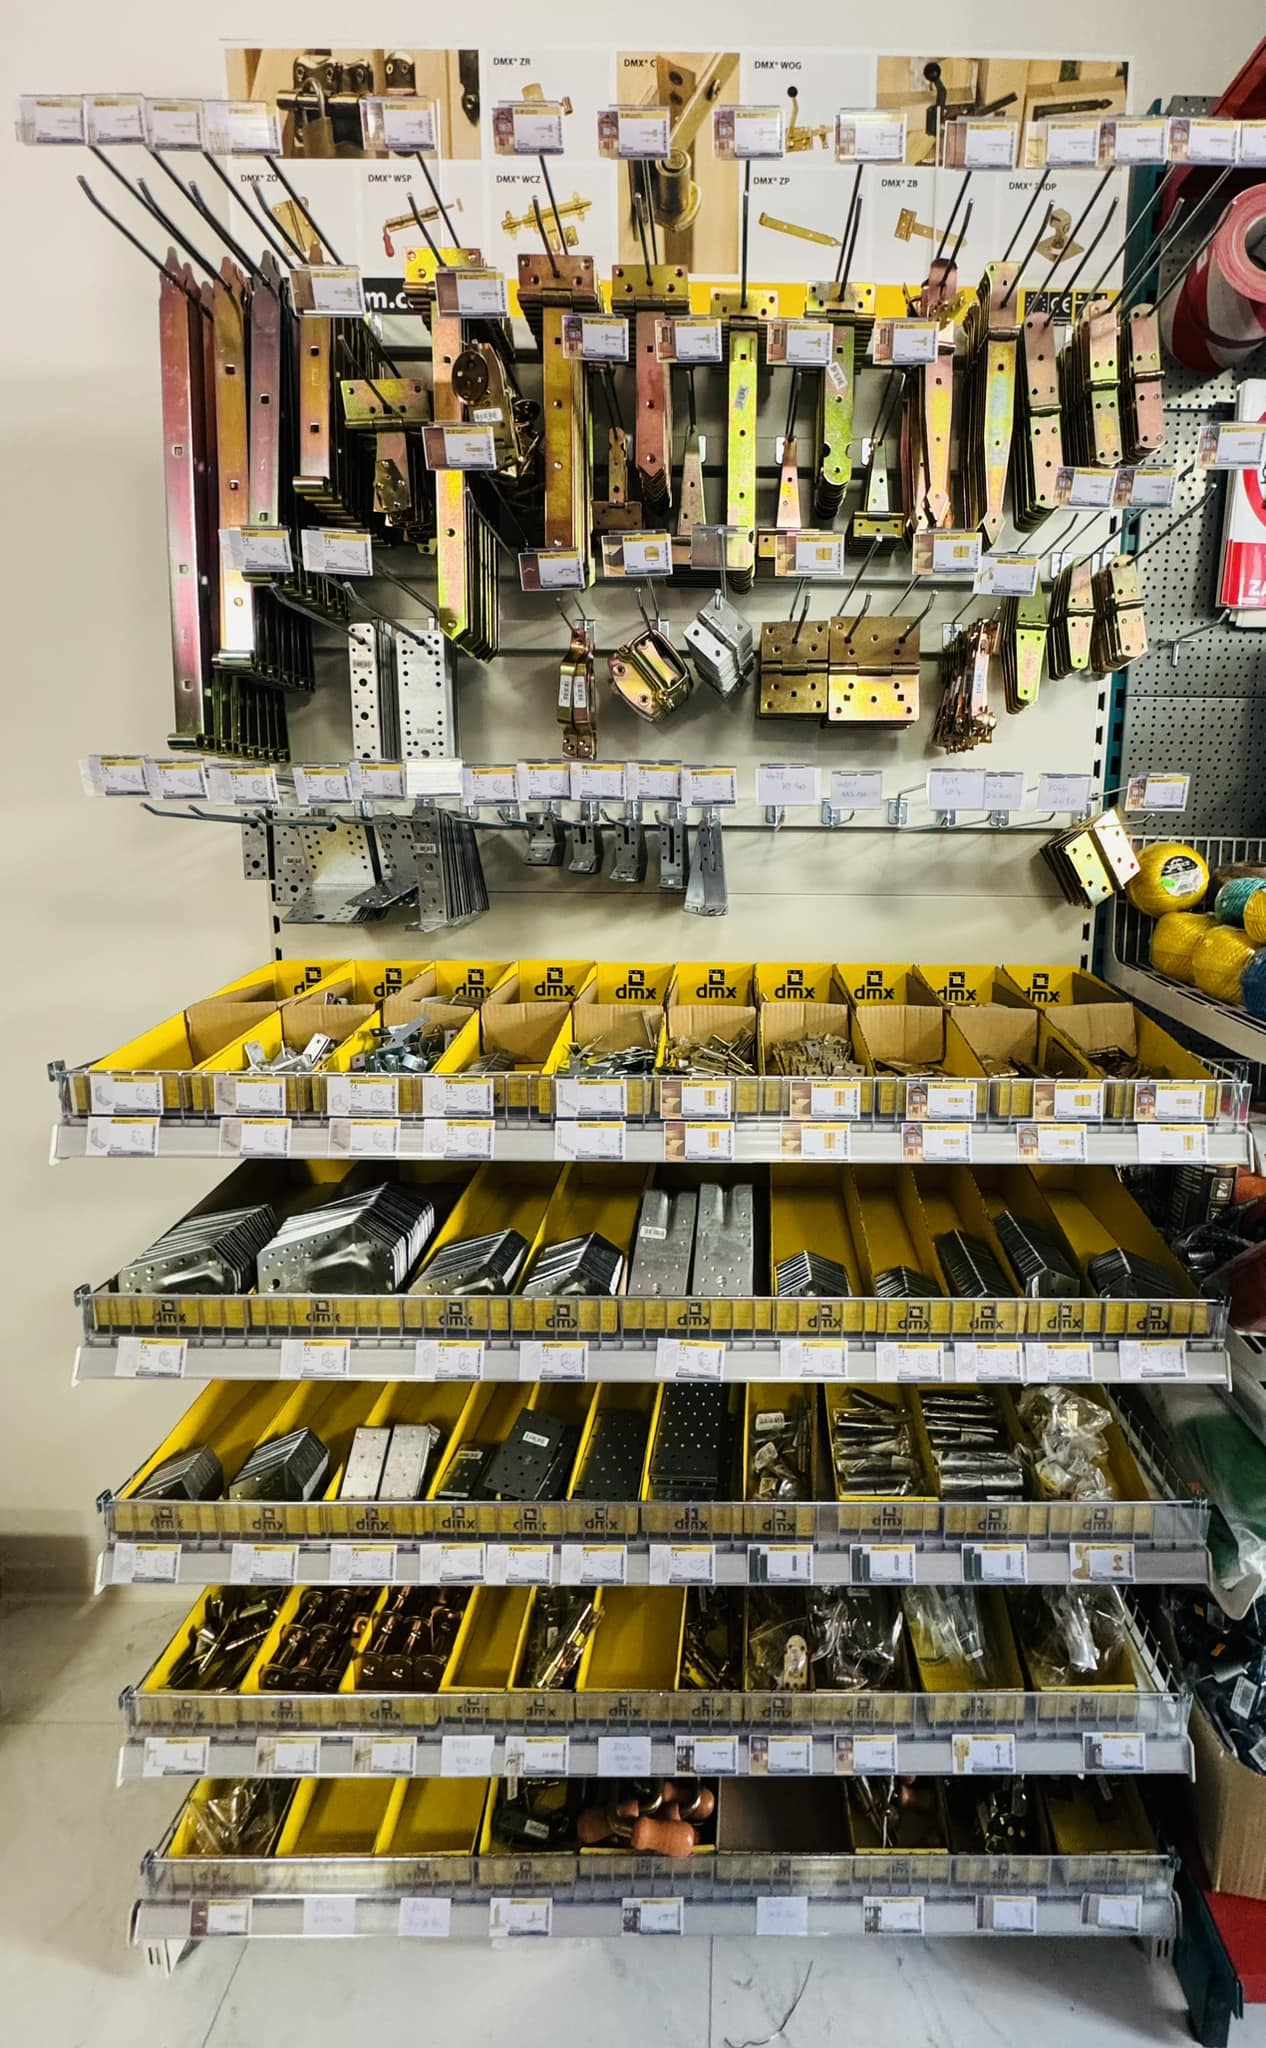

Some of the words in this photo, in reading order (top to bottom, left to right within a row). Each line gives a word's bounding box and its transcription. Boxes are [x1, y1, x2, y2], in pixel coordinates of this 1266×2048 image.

[519, 57, 531, 66] ZR
[780, 60, 802, 70] WOG
[394, 174, 412, 183] WSP
[522, 175, 541, 184] WCZ
[778, 176, 791, 186] ZP
[906, 178, 918, 188] ZB
[373, 982, 402, 999] dm
[534, 981, 575, 997] dmx
[615, 984, 657, 1000] dmx
[696, 983, 736, 999] dmx
[774, 984, 815, 999] dmx
[854, 984, 894, 1000] dmx
[677, 1314, 710, 1327] dmx
[808, 1315, 842, 1328] dmx
[970, 1317, 1004, 1329] dmx
